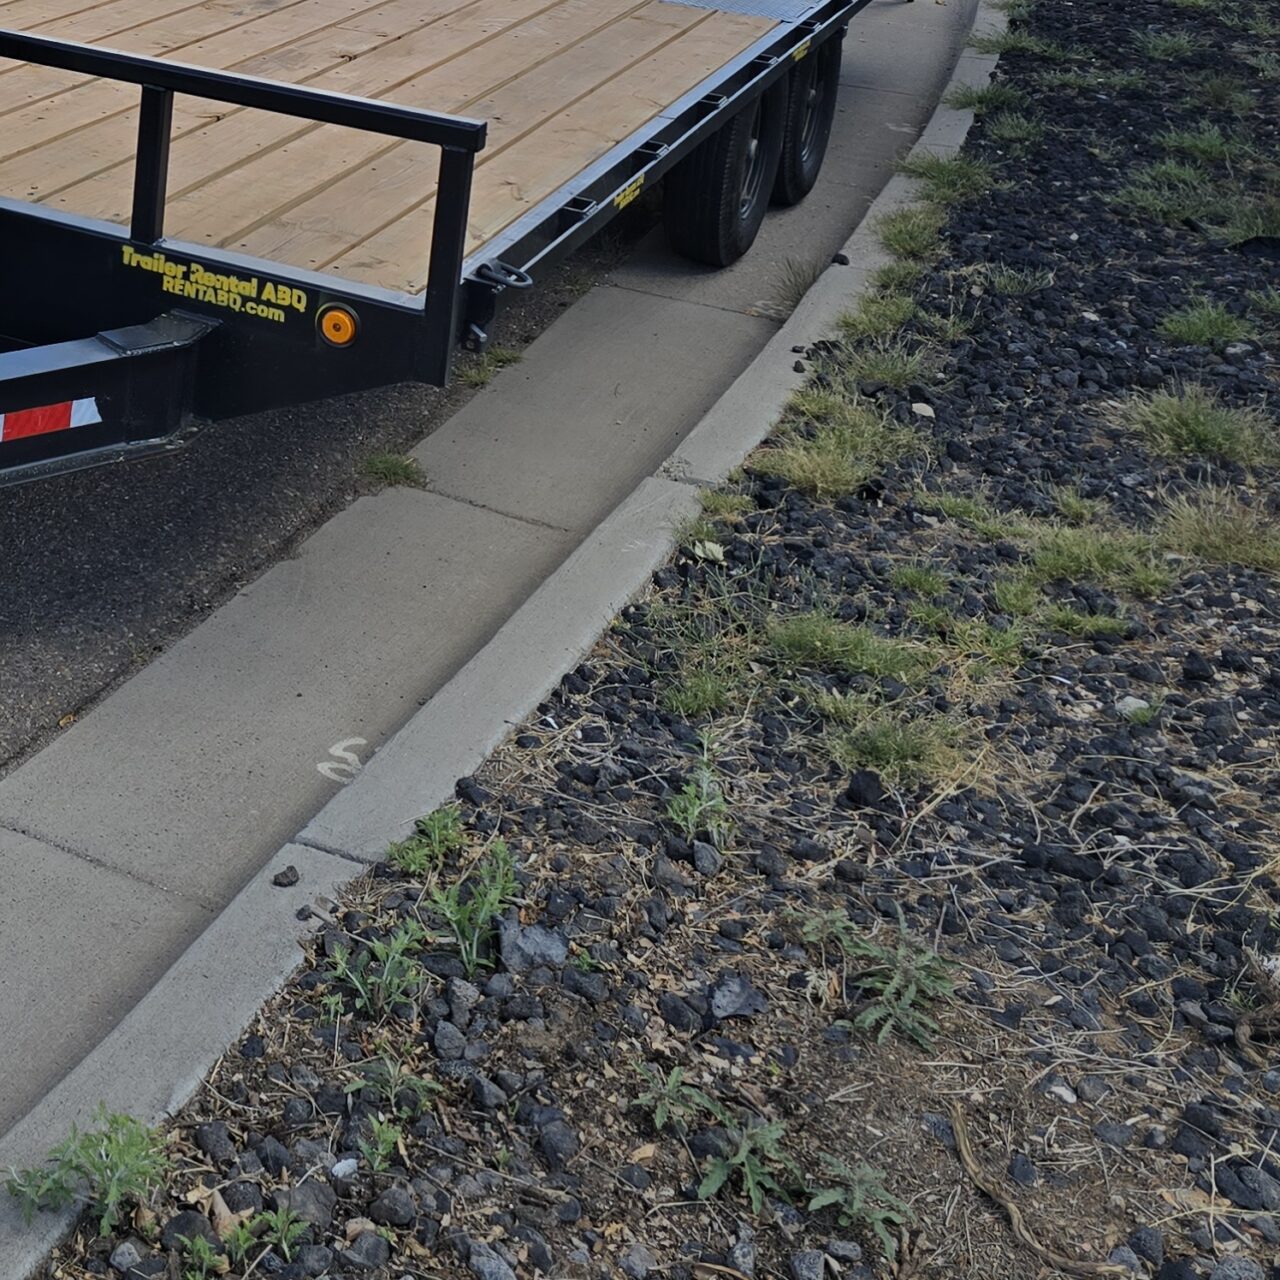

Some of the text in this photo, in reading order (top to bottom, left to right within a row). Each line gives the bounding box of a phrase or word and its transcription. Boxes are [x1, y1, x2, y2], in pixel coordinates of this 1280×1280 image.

[122, 245, 307, 312] Trailer Rental ABQ
[163, 276, 285, 322] RENTABQ.com
